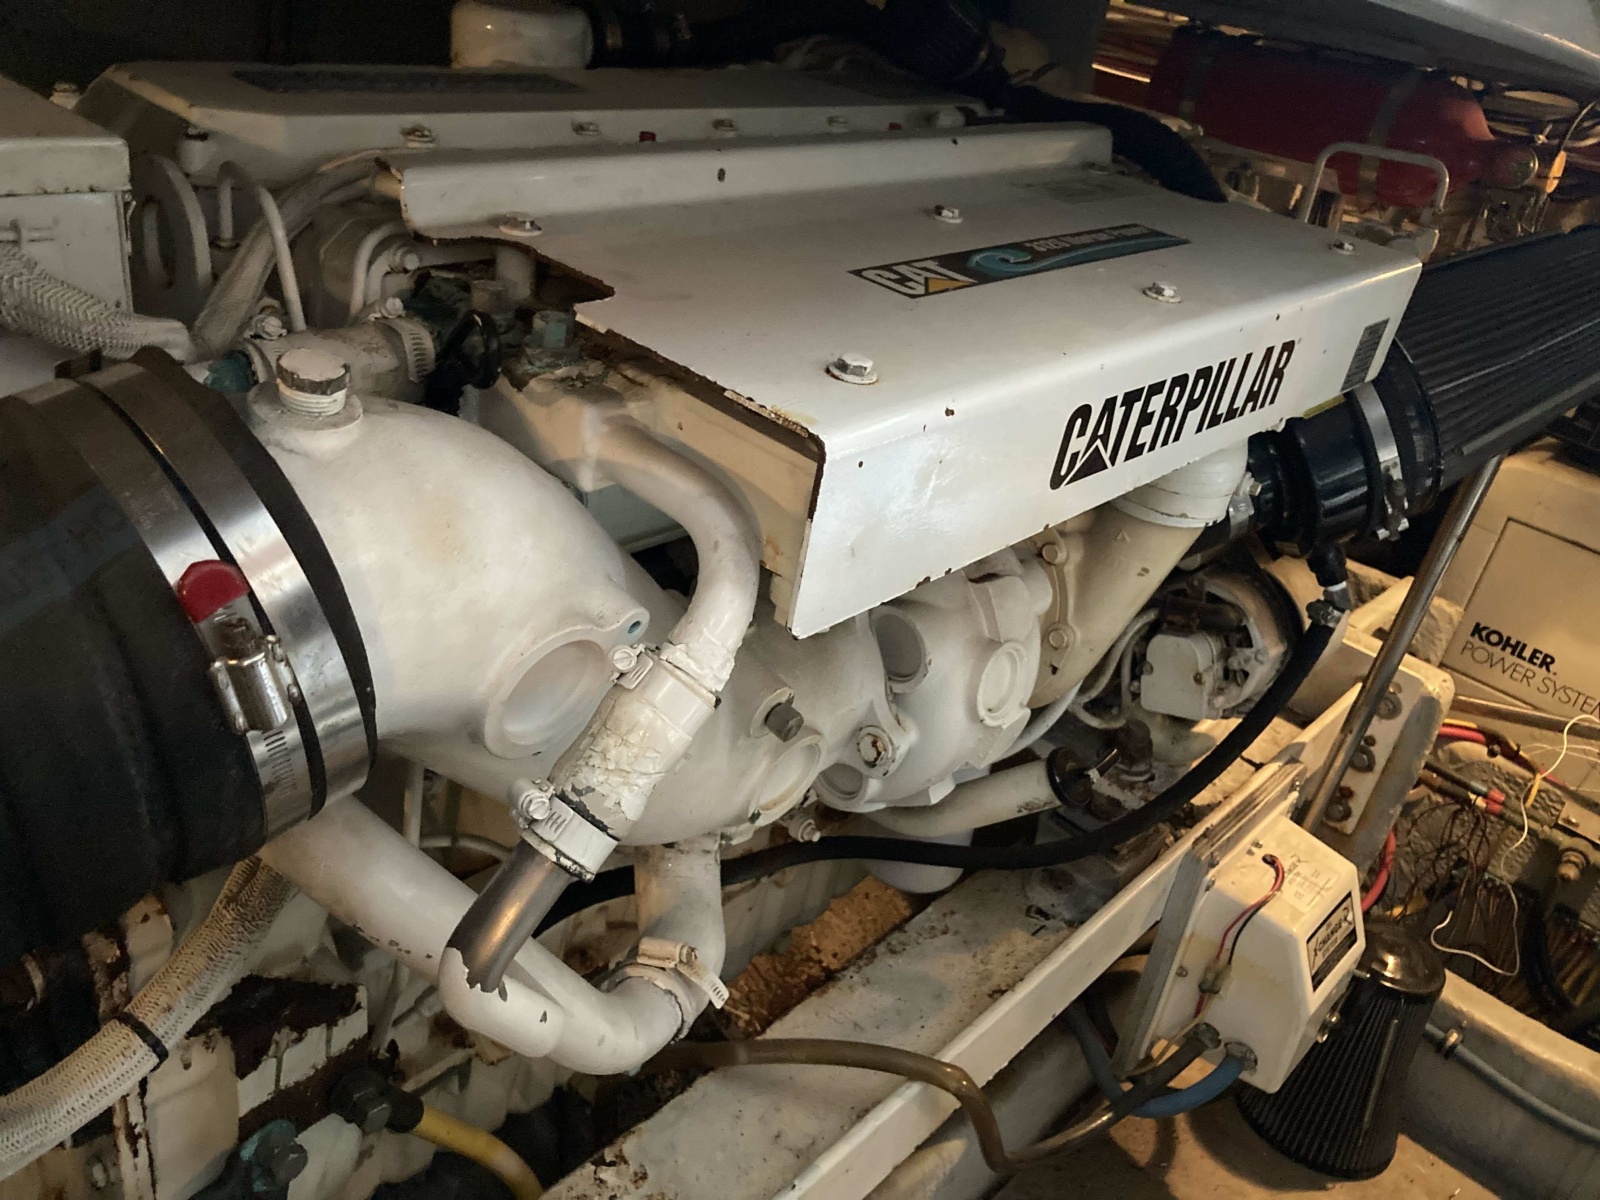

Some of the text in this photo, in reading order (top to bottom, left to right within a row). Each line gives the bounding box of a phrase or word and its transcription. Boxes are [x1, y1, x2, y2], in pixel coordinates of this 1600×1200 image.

[861, 260, 976, 295] CAT
[1049, 340, 1295, 490] CATERPILLAR
[1461, 641, 1535, 687] POWER
